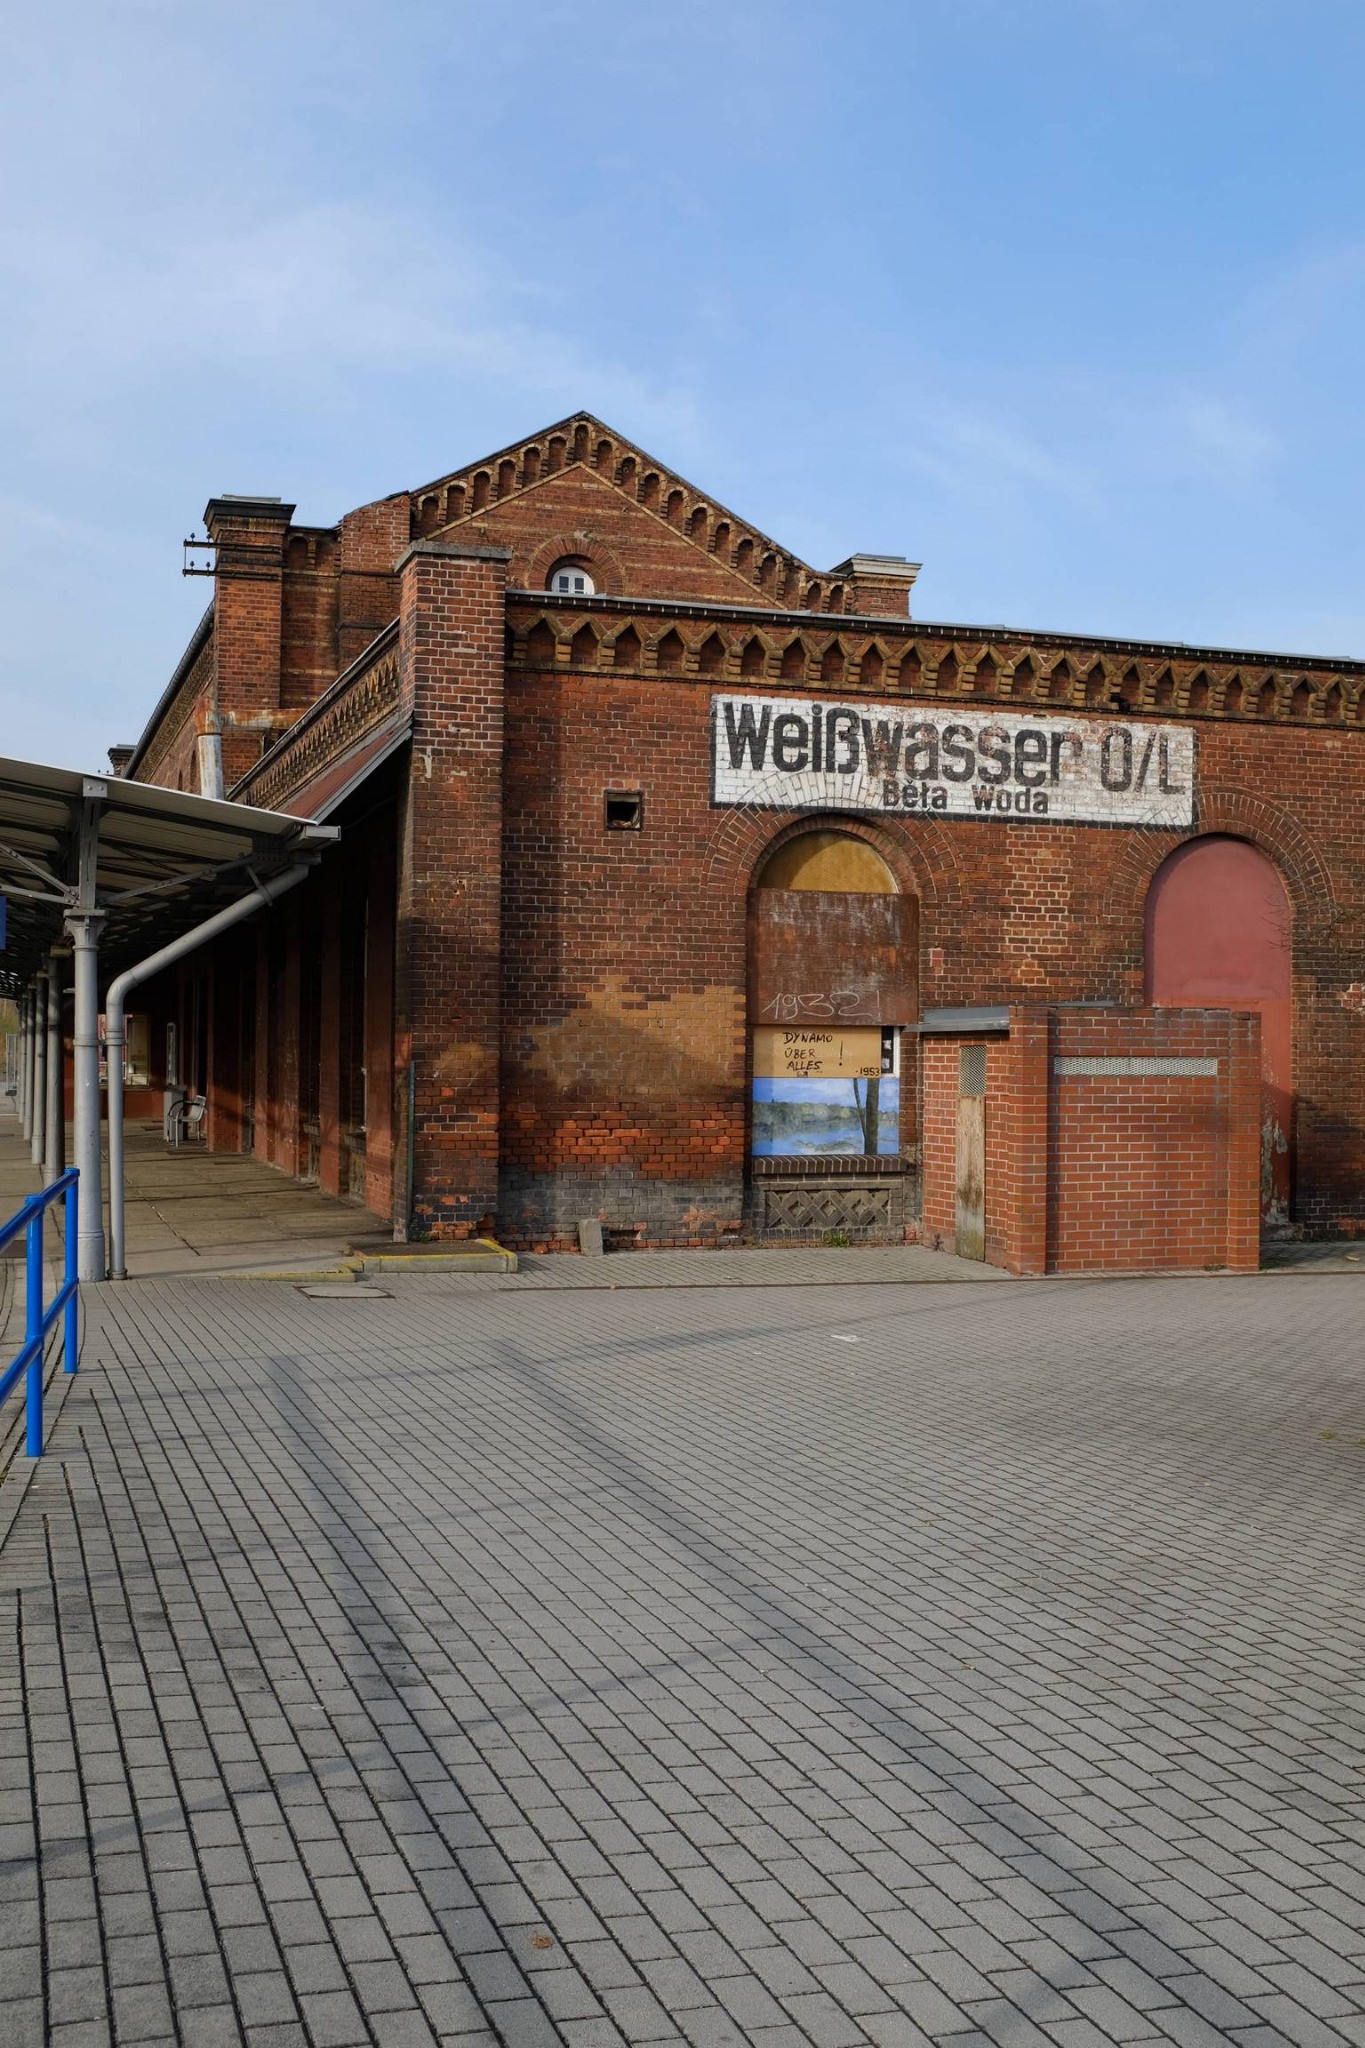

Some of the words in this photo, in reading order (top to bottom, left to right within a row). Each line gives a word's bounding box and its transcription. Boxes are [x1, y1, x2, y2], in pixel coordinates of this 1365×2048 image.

[723, 702, 1083, 787] Weißwasser
[1101, 727, 1185, 794] O/L
[783, 1032, 833, 1045] DYNAMO
[784, 1047, 817, 1060] ÜBER
[786, 1060, 823, 1072] ALLES
